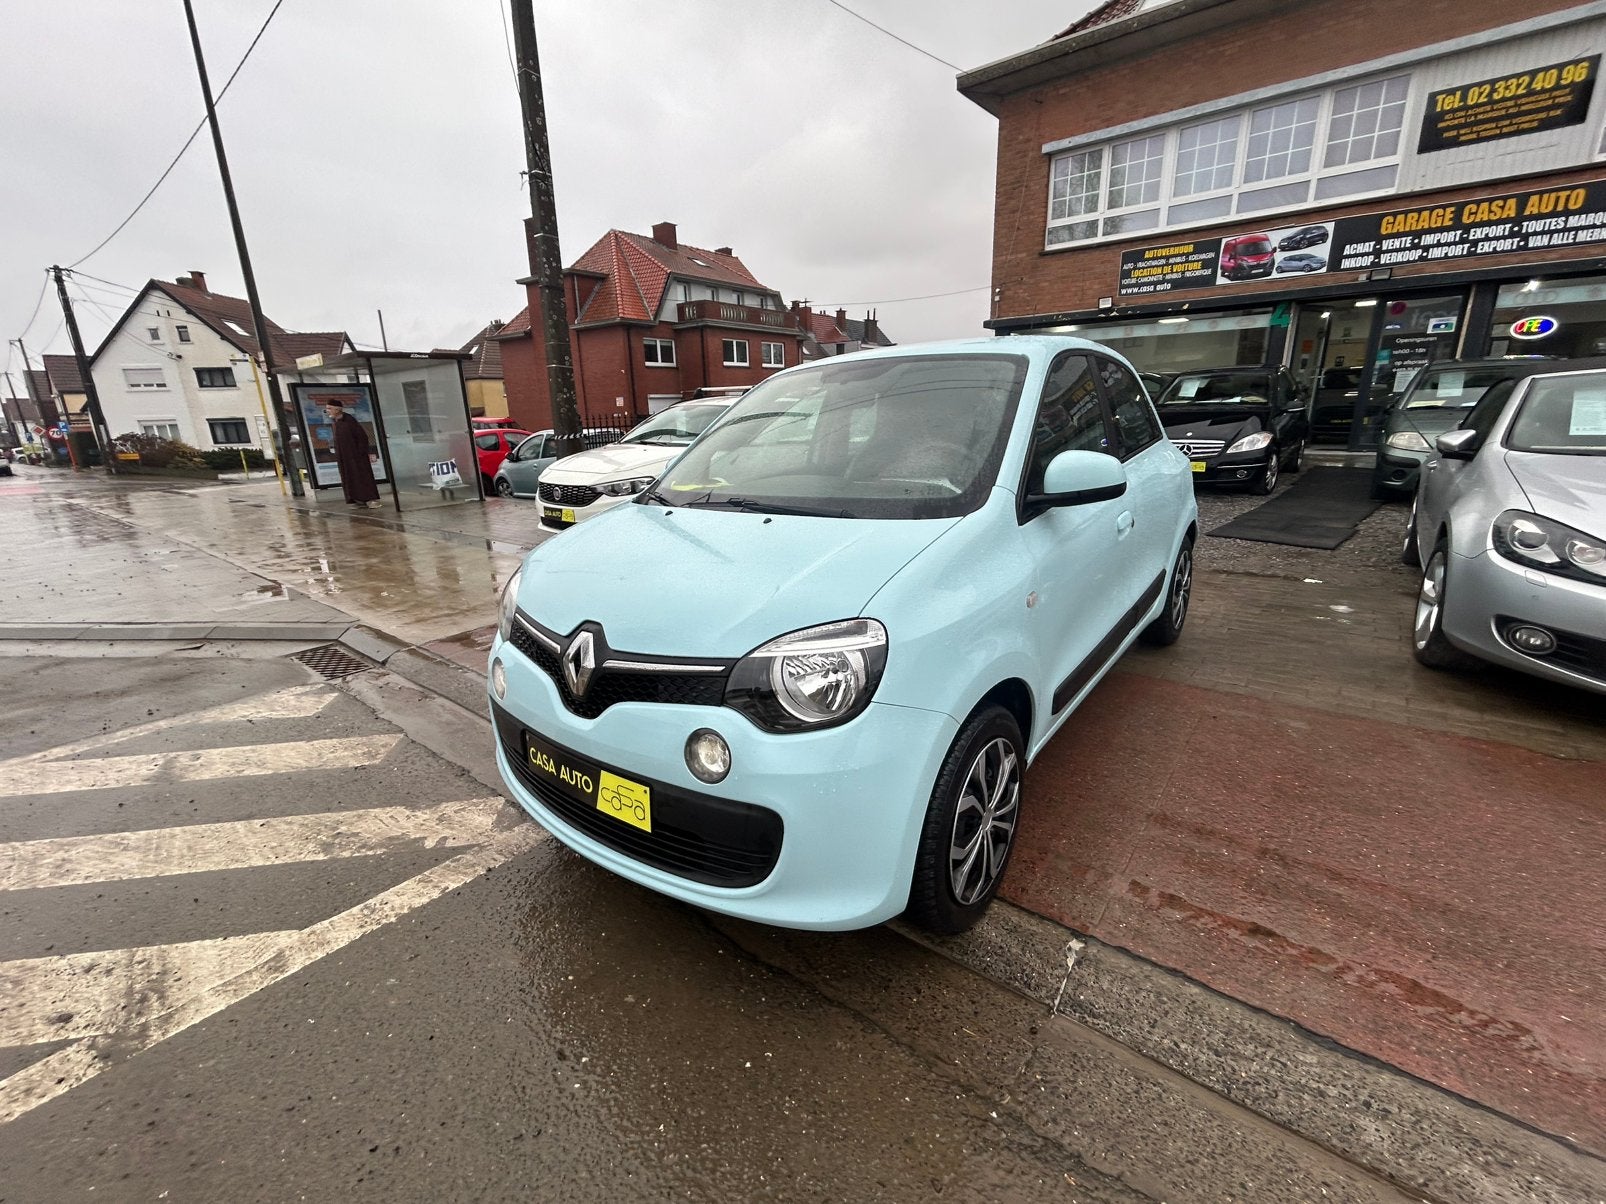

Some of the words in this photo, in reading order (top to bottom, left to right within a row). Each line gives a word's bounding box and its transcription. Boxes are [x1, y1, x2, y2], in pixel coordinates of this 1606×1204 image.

[1467, 84, 1491, 106] 02
[1492, 75, 1530, 100] 332
[1531, 68, 1558, 91] 40
[1560, 61, 1590, 85] 96
[1380, 207, 1456, 235] GARAGE
[1462, 198, 1517, 224] CASA
[1523, 188, 1586, 215] AUTO
[1144, 244, 1193, 258] AUTOVERHUUR
[1341, 255, 1374, 269] INKOOP
[1380, 249, 1422, 264] VERKOOP
[1428, 243, 1470, 259] IMPORT
[1477, 237, 1520, 253] EXPORT
[1528, 235, 1549, 247] VAN
[1550, 231, 1575, 245] ALLE
[1343, 241, 1376, 255] ACHAT
[1381, 236, 1412, 251] VENTE
[1420, 230, 1462, 246] IMPORT
[1469, 223, 1512, 240] EXPORT
[1521, 216, 1566, 233] TOUTES
[1120, 284, 1153, 294] www.casa
[1155, 282, 1171, 290] auto
[1131, 266, 1162, 277] LOCATION
[1163, 265, 1171, 273] DE
[1172, 261, 1201, 272] VOITURE
[530, 747, 556, 776] CASA
[560, 764, 593, 793] AUTO
